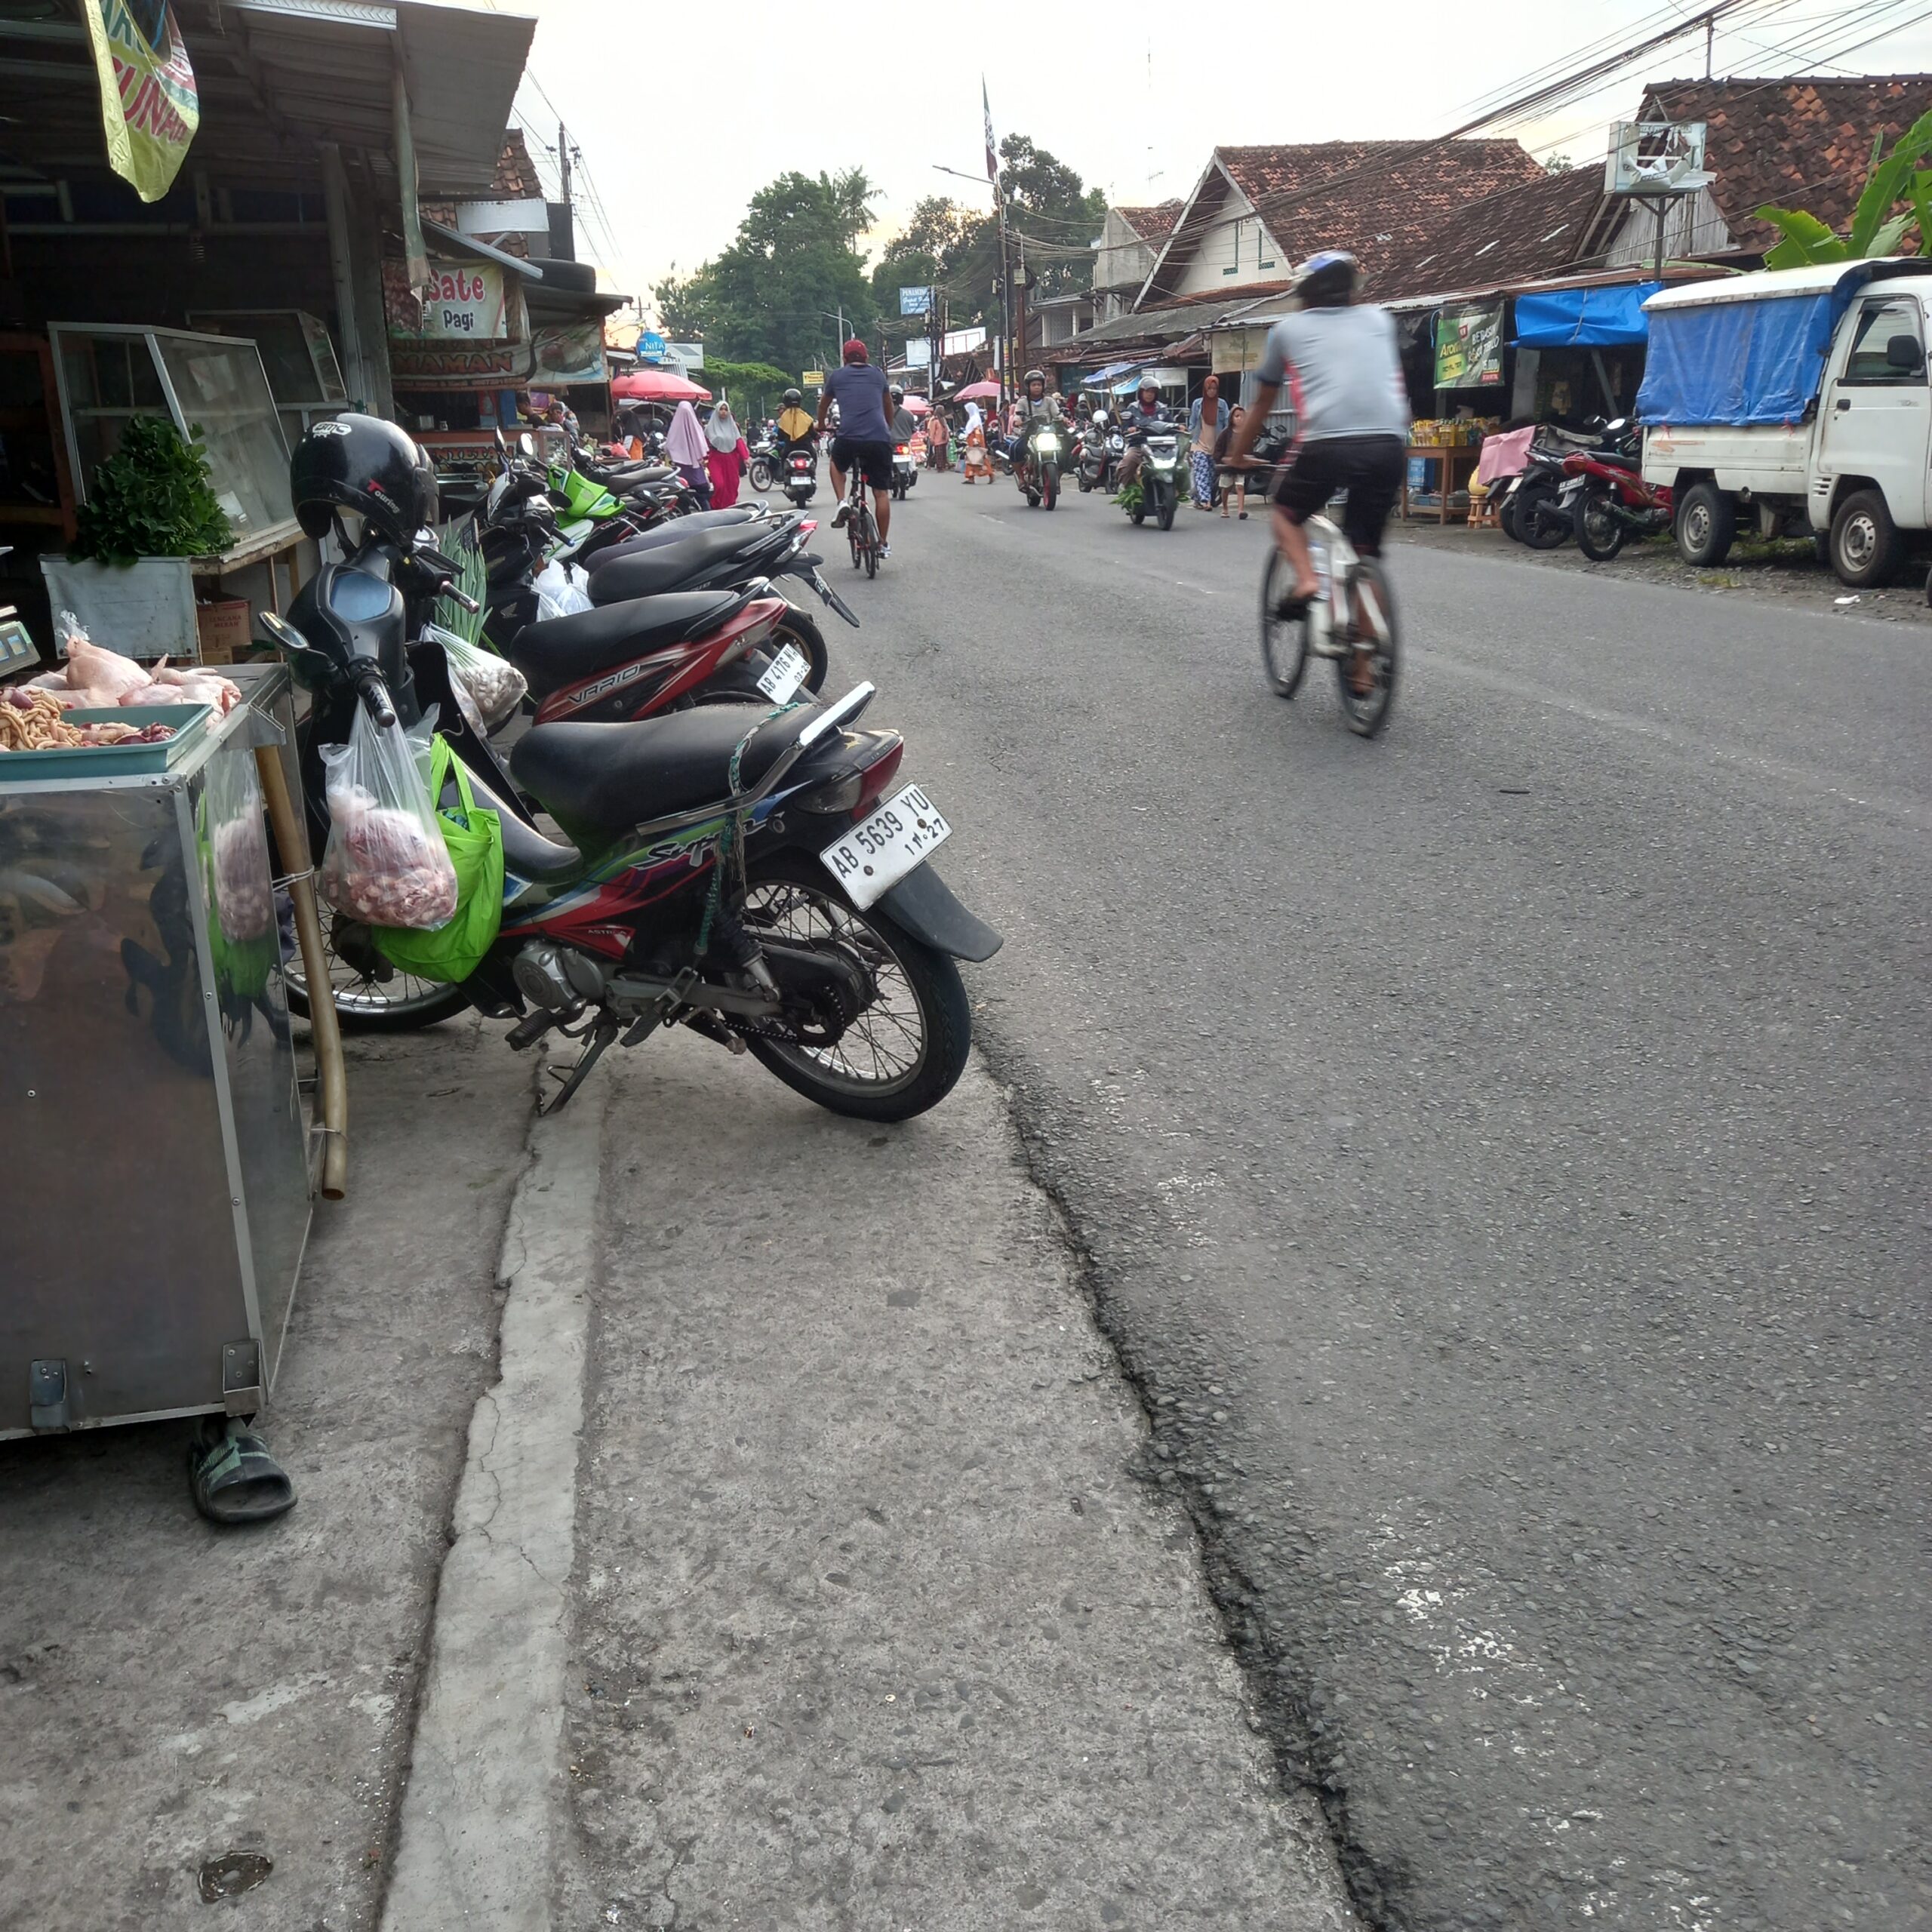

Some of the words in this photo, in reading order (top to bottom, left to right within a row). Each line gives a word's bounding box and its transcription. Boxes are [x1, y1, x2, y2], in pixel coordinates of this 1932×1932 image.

[429, 269, 485, 301] Sate
[443, 309, 474, 331] Pagi
[392, 350, 513, 375] MAMAN
[367, 477, 401, 515] Touring
[568, 663, 641, 705] VARIO
[760, 677, 777, 694] AB
[771, 656, 792, 681] 4176
[832, 846, 859, 878] AB
[855, 811, 903, 854] 5639
[900, 789, 929, 817] YU
